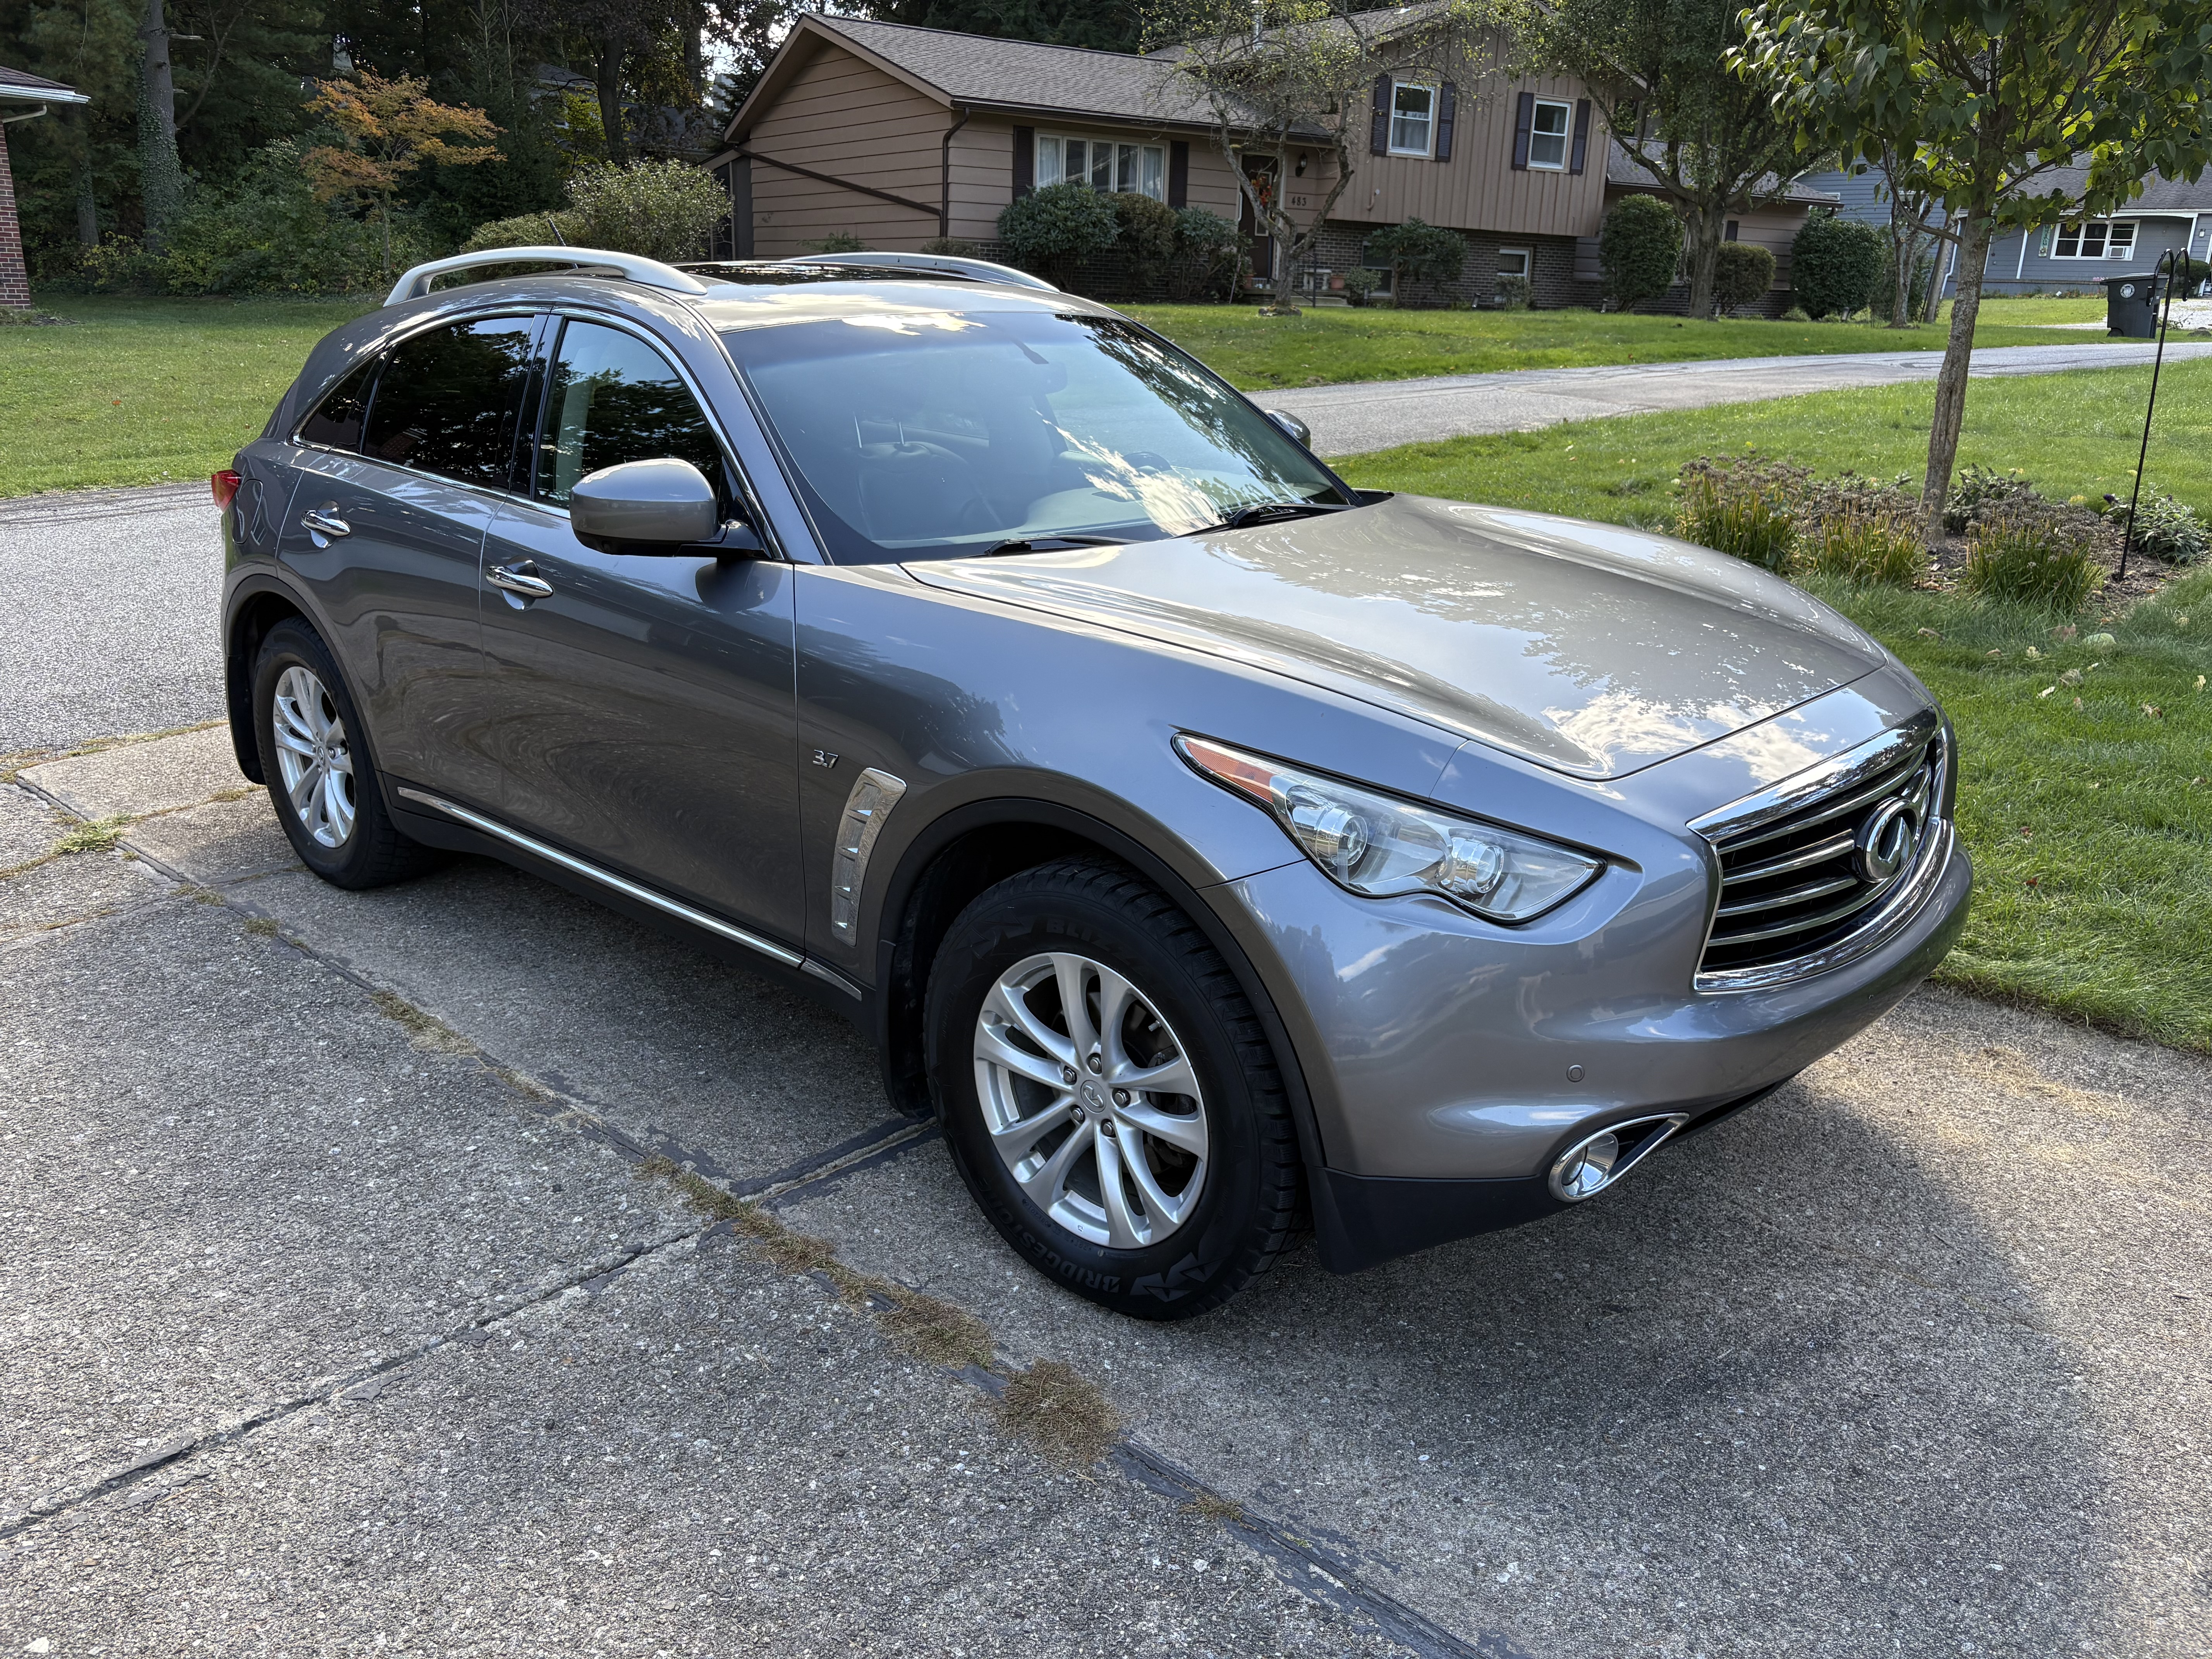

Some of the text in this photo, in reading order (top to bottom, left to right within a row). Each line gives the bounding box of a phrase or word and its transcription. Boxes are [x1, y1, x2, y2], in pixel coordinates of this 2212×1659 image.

[1291, 196, 1307, 206] 483
[813, 749, 838, 768] 3.7
[975, 1176, 1121, 1293] BRIDGESTONE
